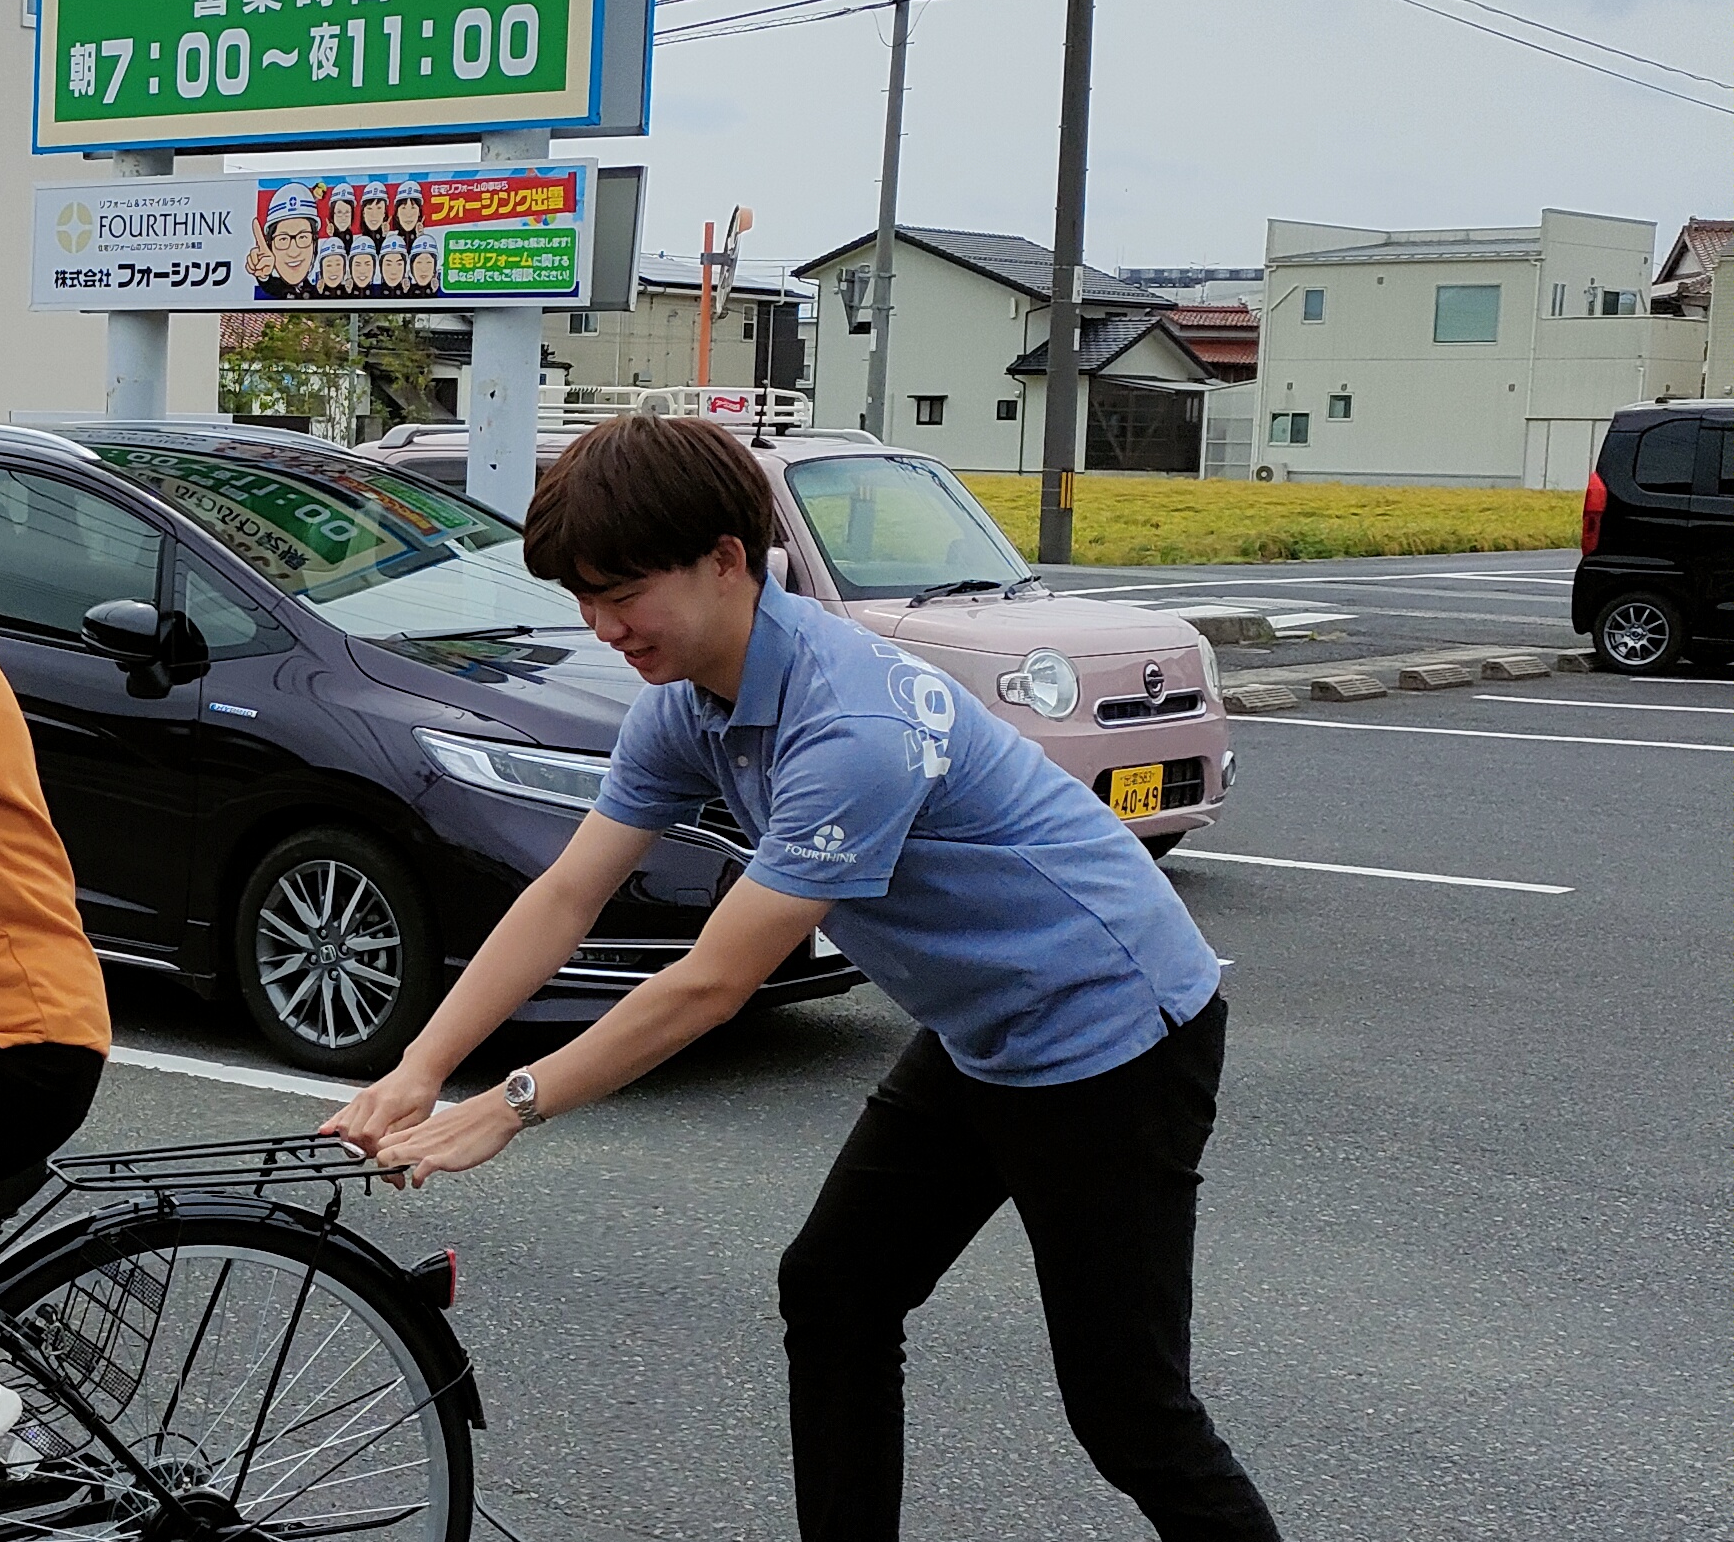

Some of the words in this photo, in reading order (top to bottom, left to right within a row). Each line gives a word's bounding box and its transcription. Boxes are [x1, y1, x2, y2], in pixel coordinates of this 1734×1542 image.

[431, 186, 564, 221] フォーシンク出雲
[99, 211, 232, 238] FOURTHINK
[54, 269, 112, 289] 株式会社
[117, 260, 232, 288] フォーシンク
[1121, 786, 1158, 815] 40-49
[785, 843, 857, 863] FOURTHINK
